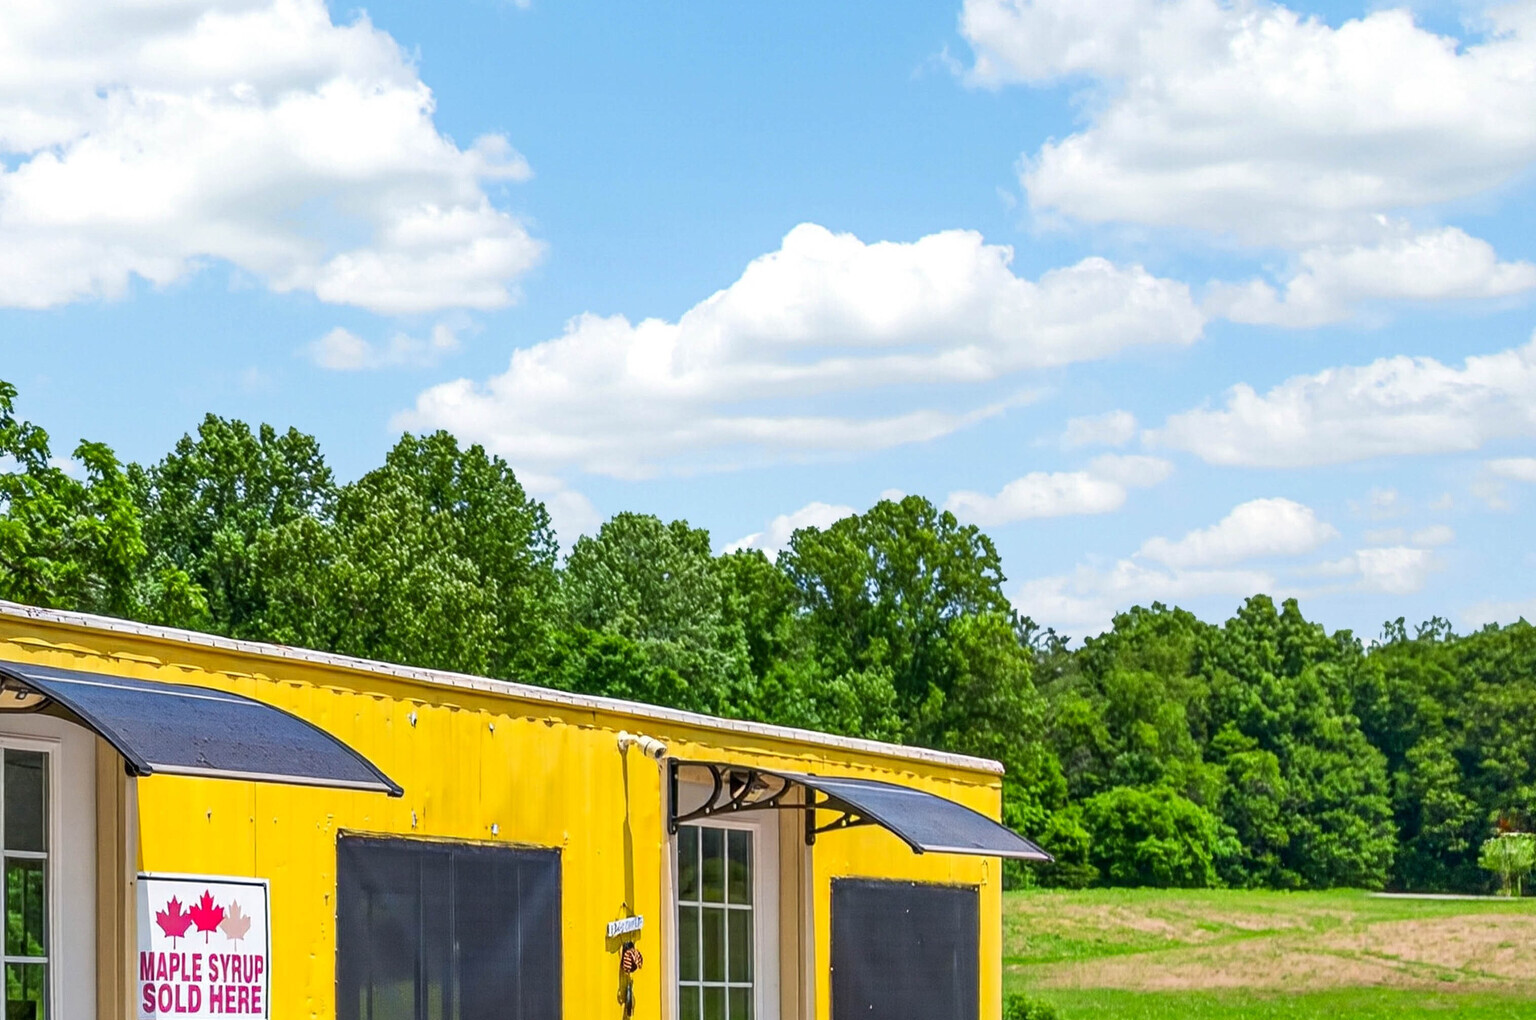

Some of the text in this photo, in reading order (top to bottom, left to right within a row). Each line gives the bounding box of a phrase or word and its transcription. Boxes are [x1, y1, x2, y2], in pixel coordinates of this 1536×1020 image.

[140, 951, 263, 983] MAPLE SYRUP
[142, 982, 262, 1014] SOLD HERE
